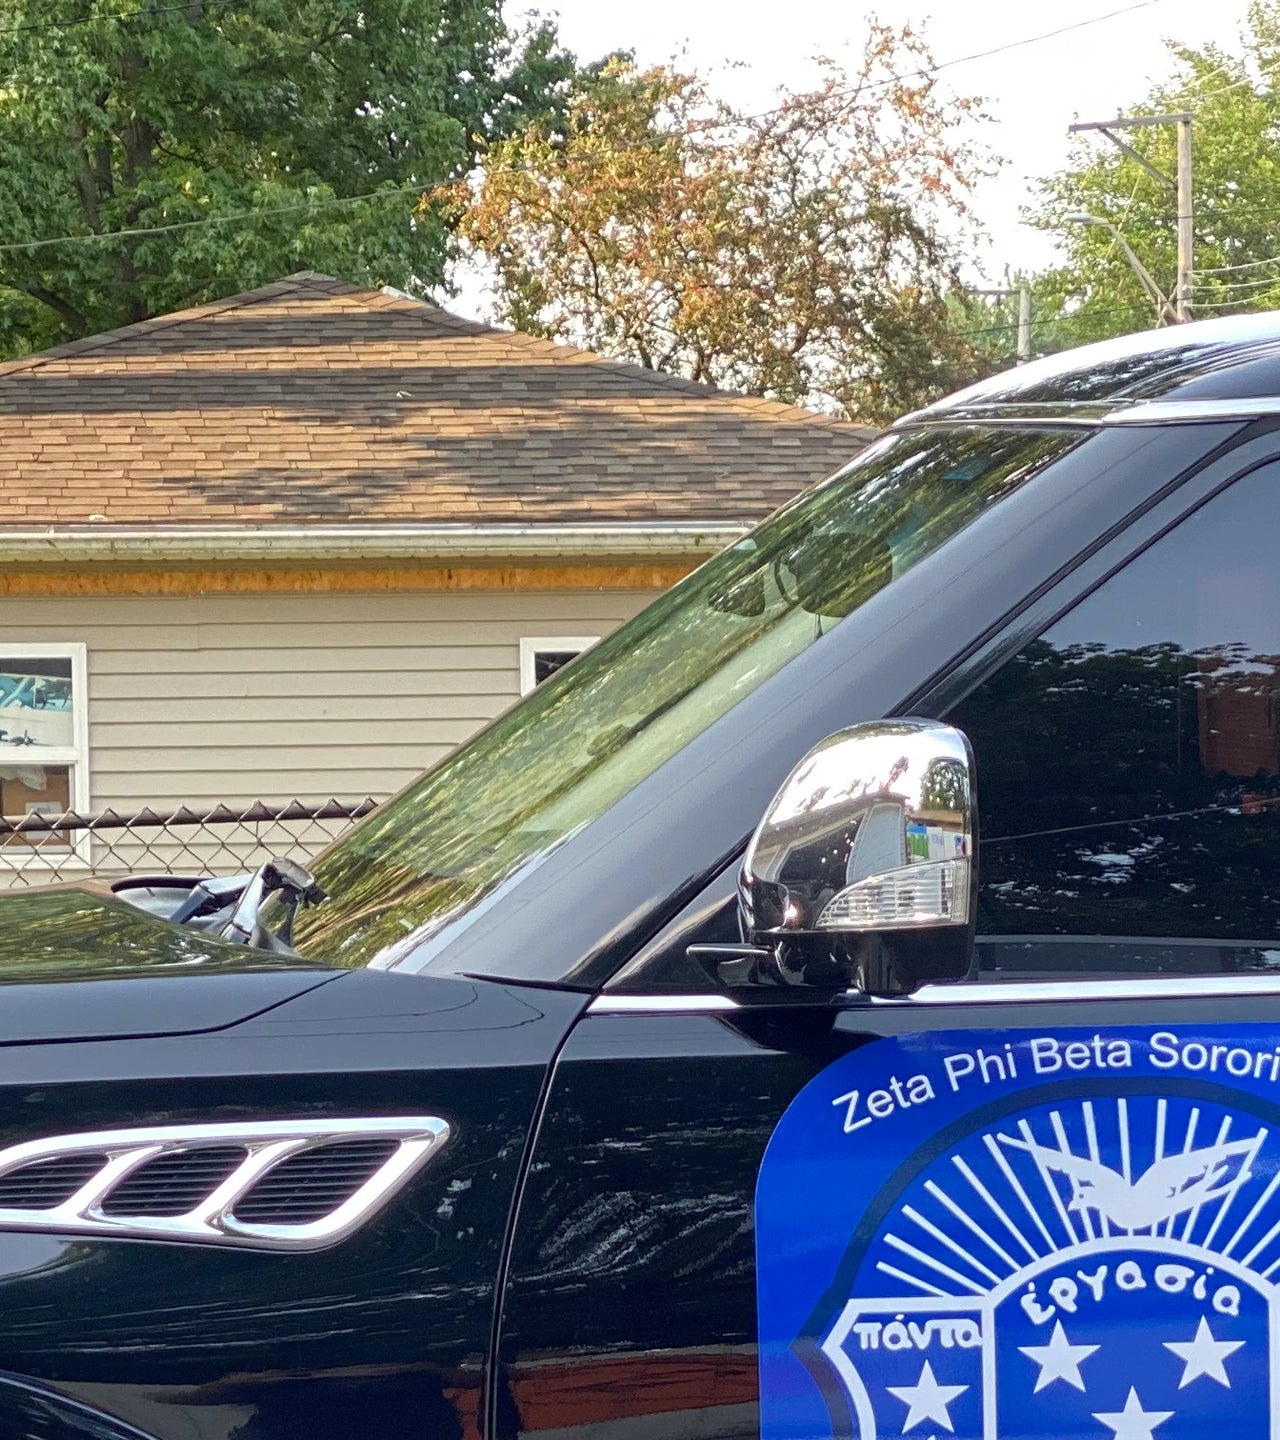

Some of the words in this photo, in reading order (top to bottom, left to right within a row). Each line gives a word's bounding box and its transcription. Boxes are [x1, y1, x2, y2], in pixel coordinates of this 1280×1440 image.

[832, 1075, 936, 1134] Zeta
[943, 1043, 1018, 1092] Phi
[1030, 1034, 1132, 1074] Beta
